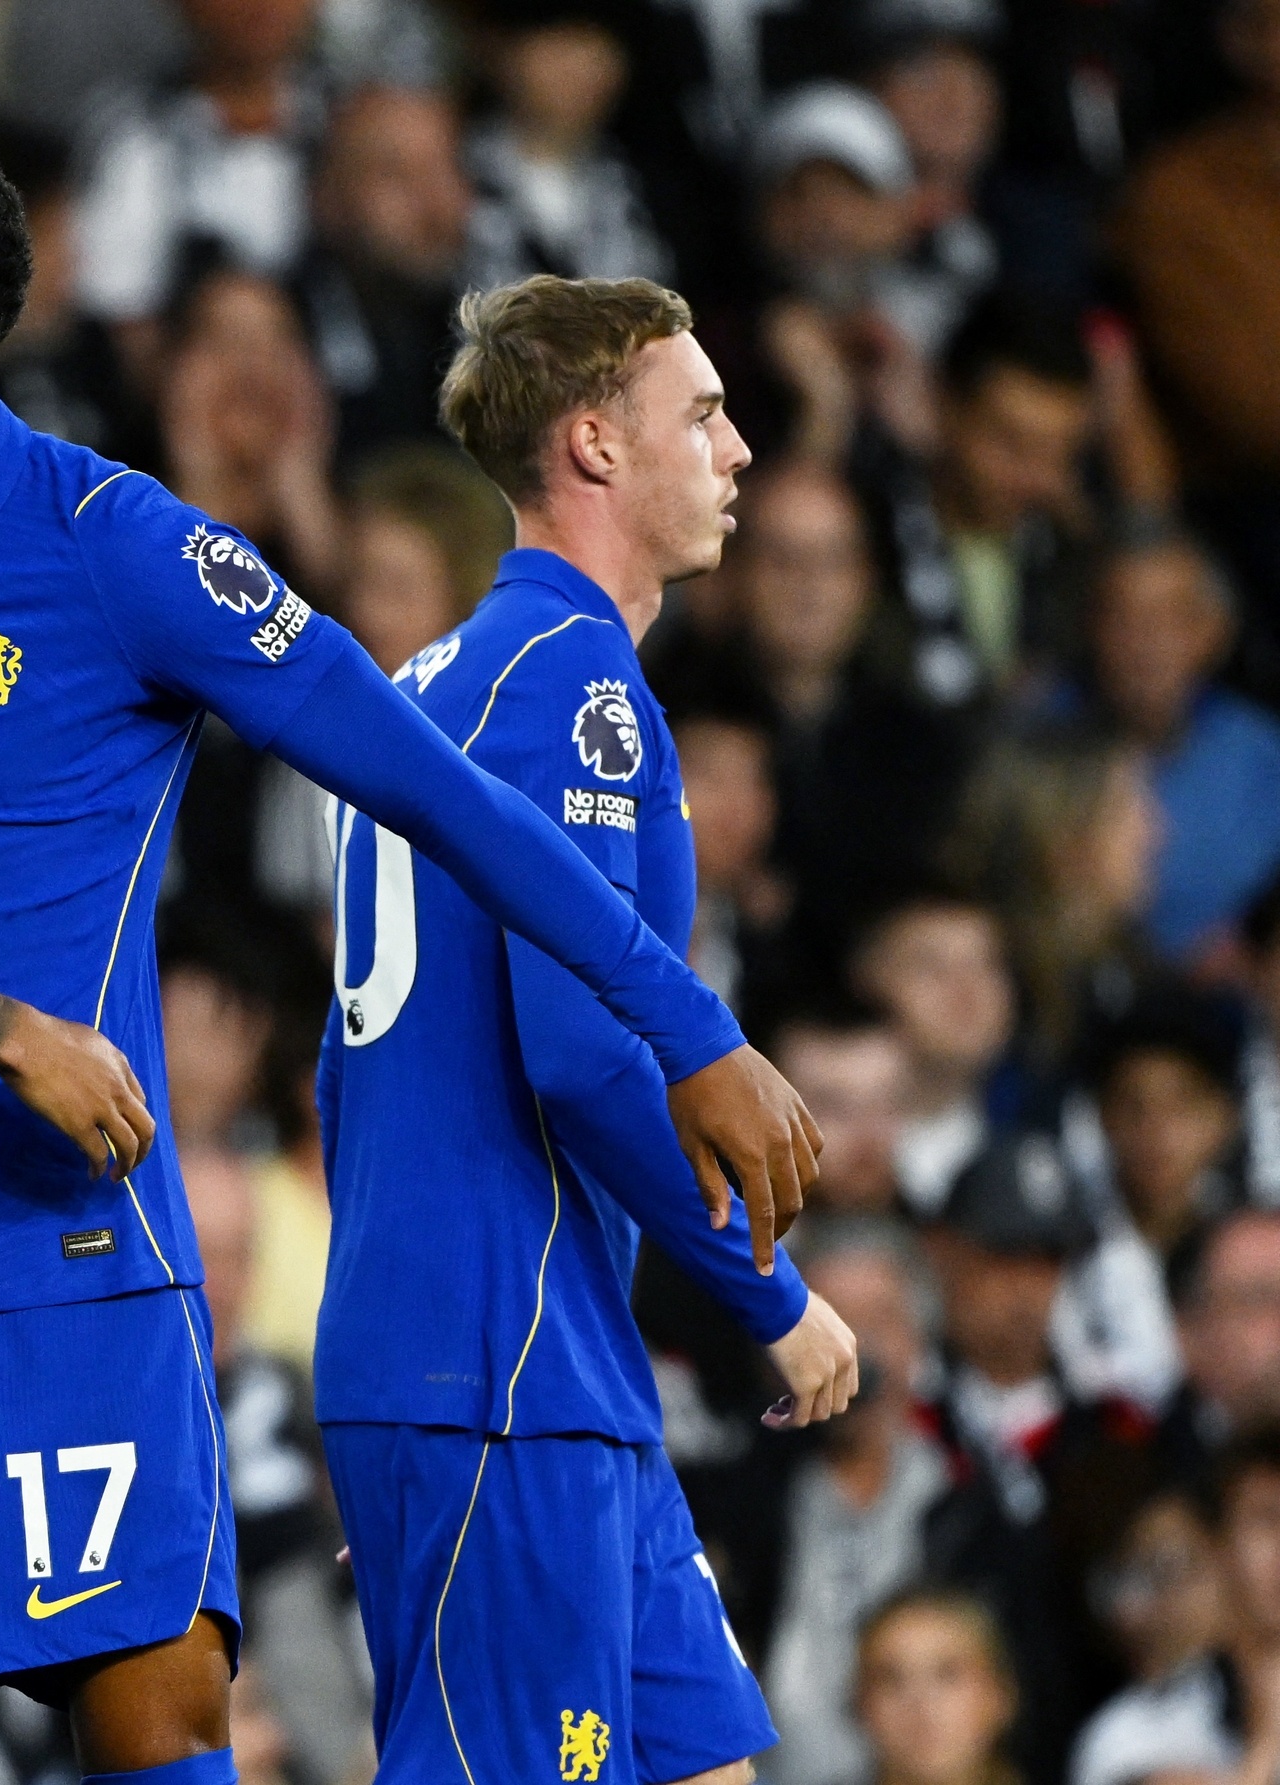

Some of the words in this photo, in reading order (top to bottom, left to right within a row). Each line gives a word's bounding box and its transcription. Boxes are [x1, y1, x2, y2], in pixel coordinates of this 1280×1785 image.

[250, 622, 279, 652] No
[263, 632, 289, 662] for
[564, 788, 594, 809] No
[597, 794, 634, 816] room
[564, 806, 593, 824] for
[6, 1441, 137, 1580] 17
